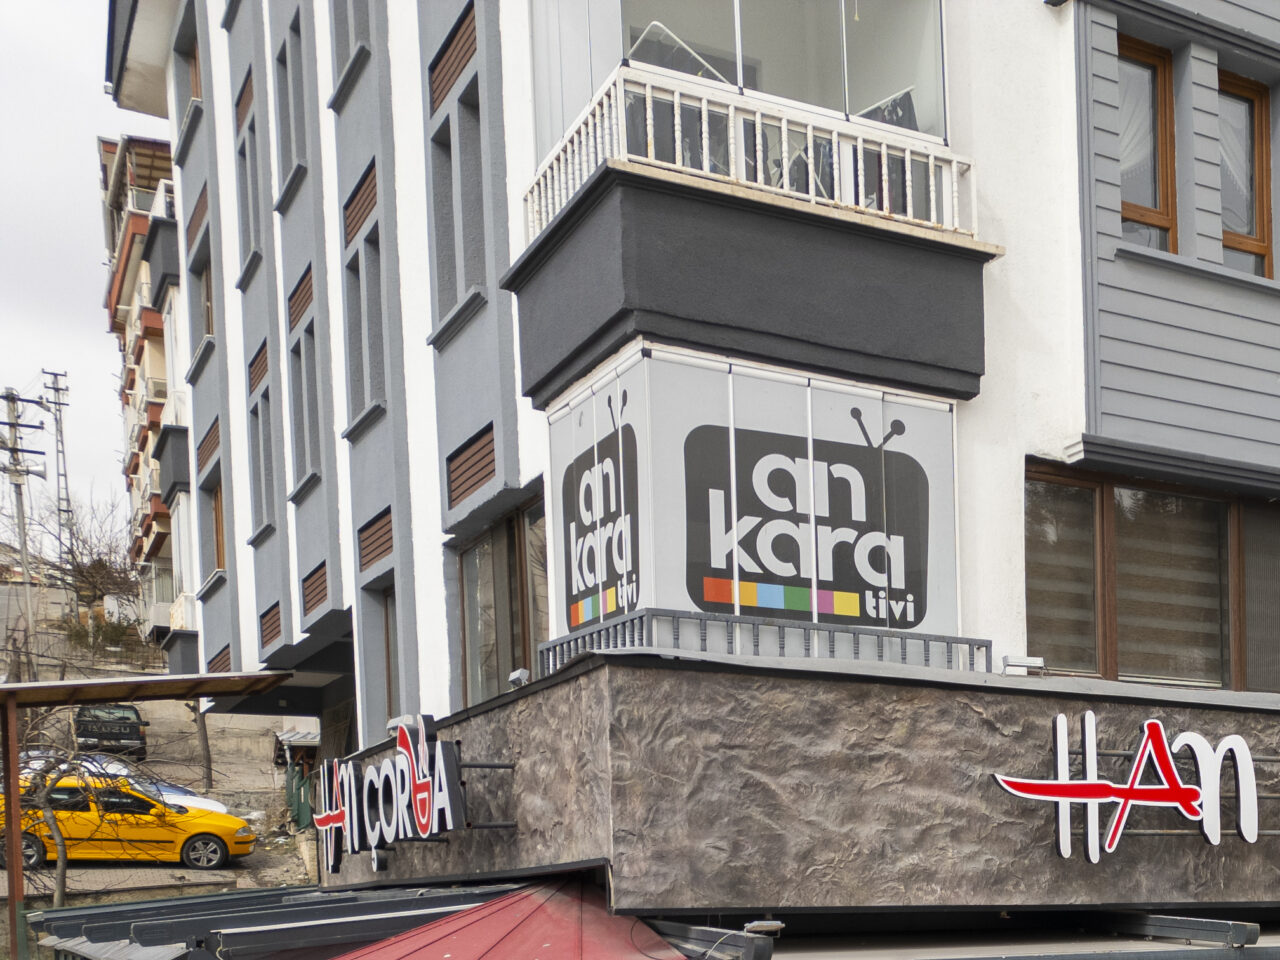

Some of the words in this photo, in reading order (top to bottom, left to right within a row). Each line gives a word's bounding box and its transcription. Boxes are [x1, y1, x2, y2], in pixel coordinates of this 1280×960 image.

[578, 457, 616, 526] an
[752, 453, 866, 522] an
[570, 514, 632, 595] kara
[708, 488, 905, 589] kara
[864, 589, 914, 622] tivi
[363, 716, 453, 872] ÇORBA
